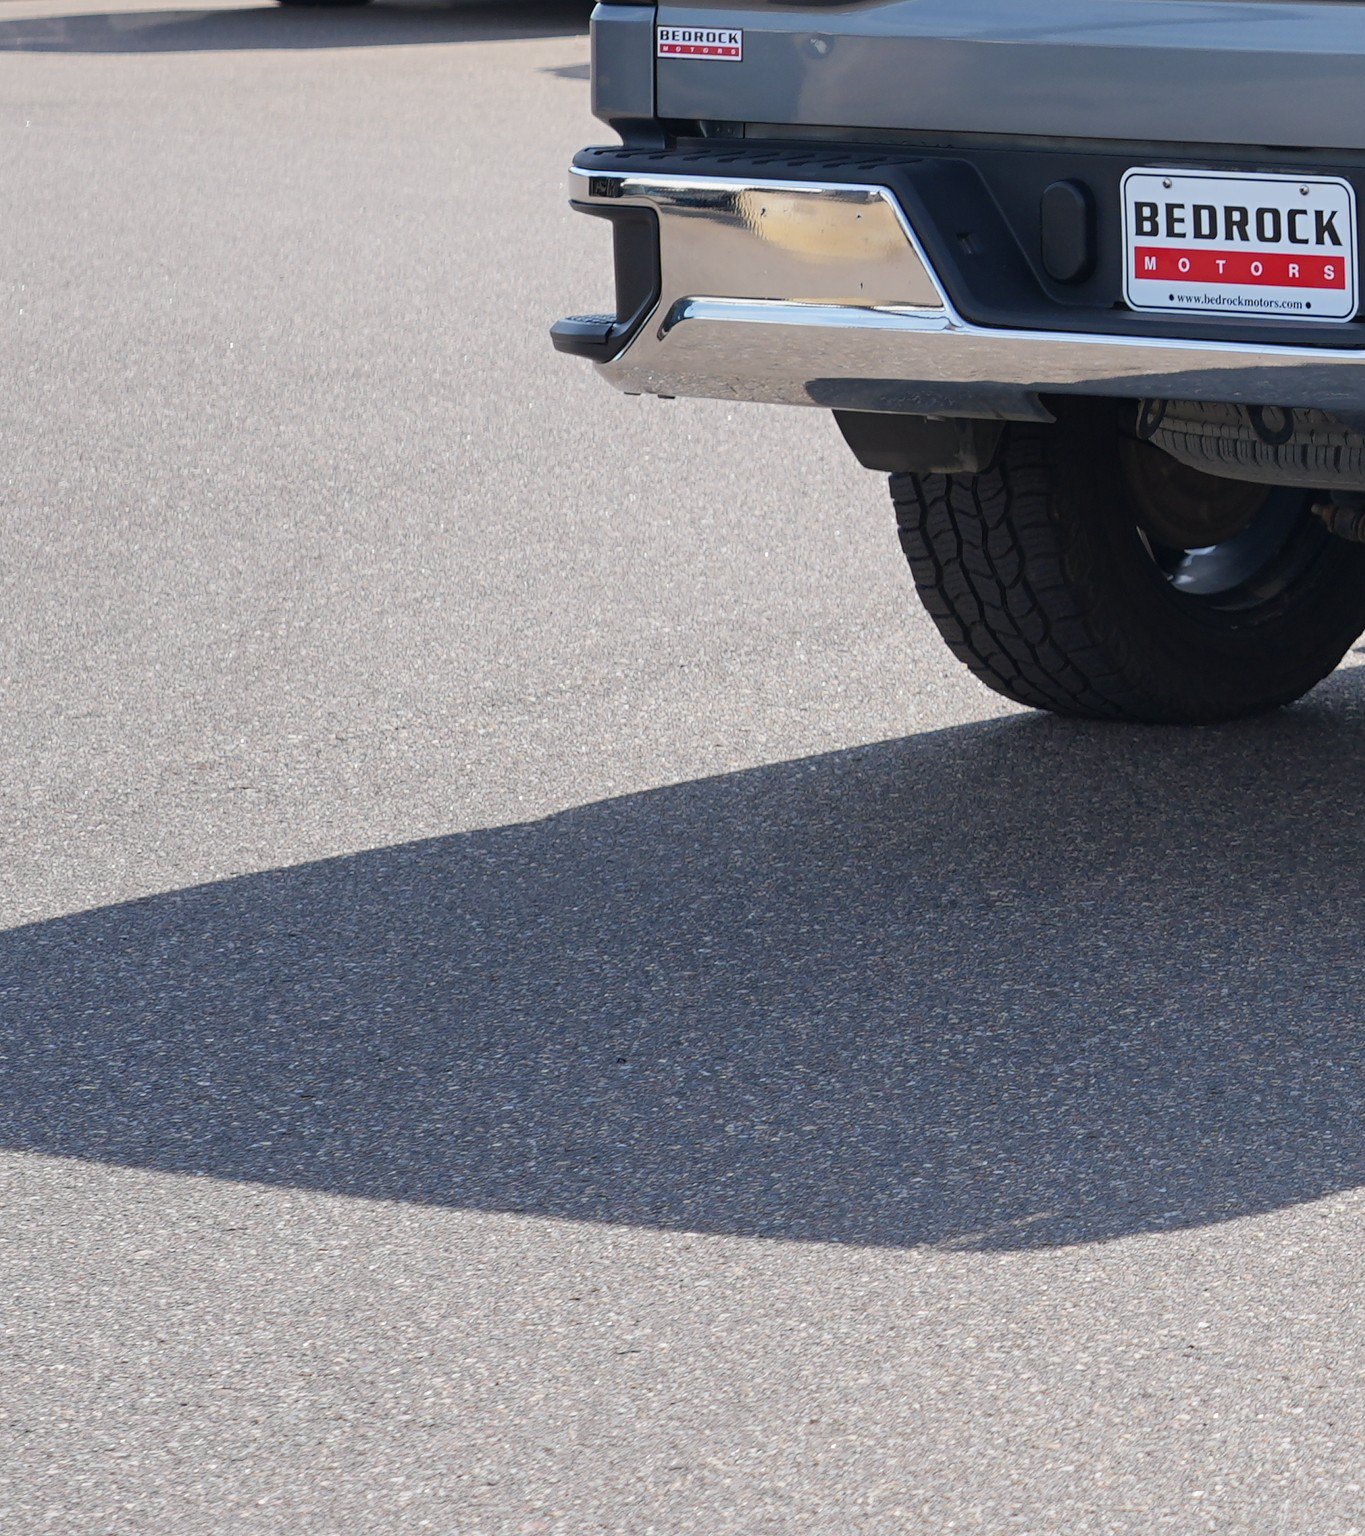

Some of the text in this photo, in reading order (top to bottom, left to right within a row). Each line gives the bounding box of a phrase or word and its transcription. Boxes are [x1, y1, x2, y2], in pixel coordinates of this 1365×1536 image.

[660, 30, 738, 44] BEDROCK
[663, 45, 736, 55] MOTORS
[1134, 201, 1343, 246] BEDROCK
[1144, 255, 1335, 280] MOTORS
[1177, 293, 1303, 310] www.bedrockmotors.com
